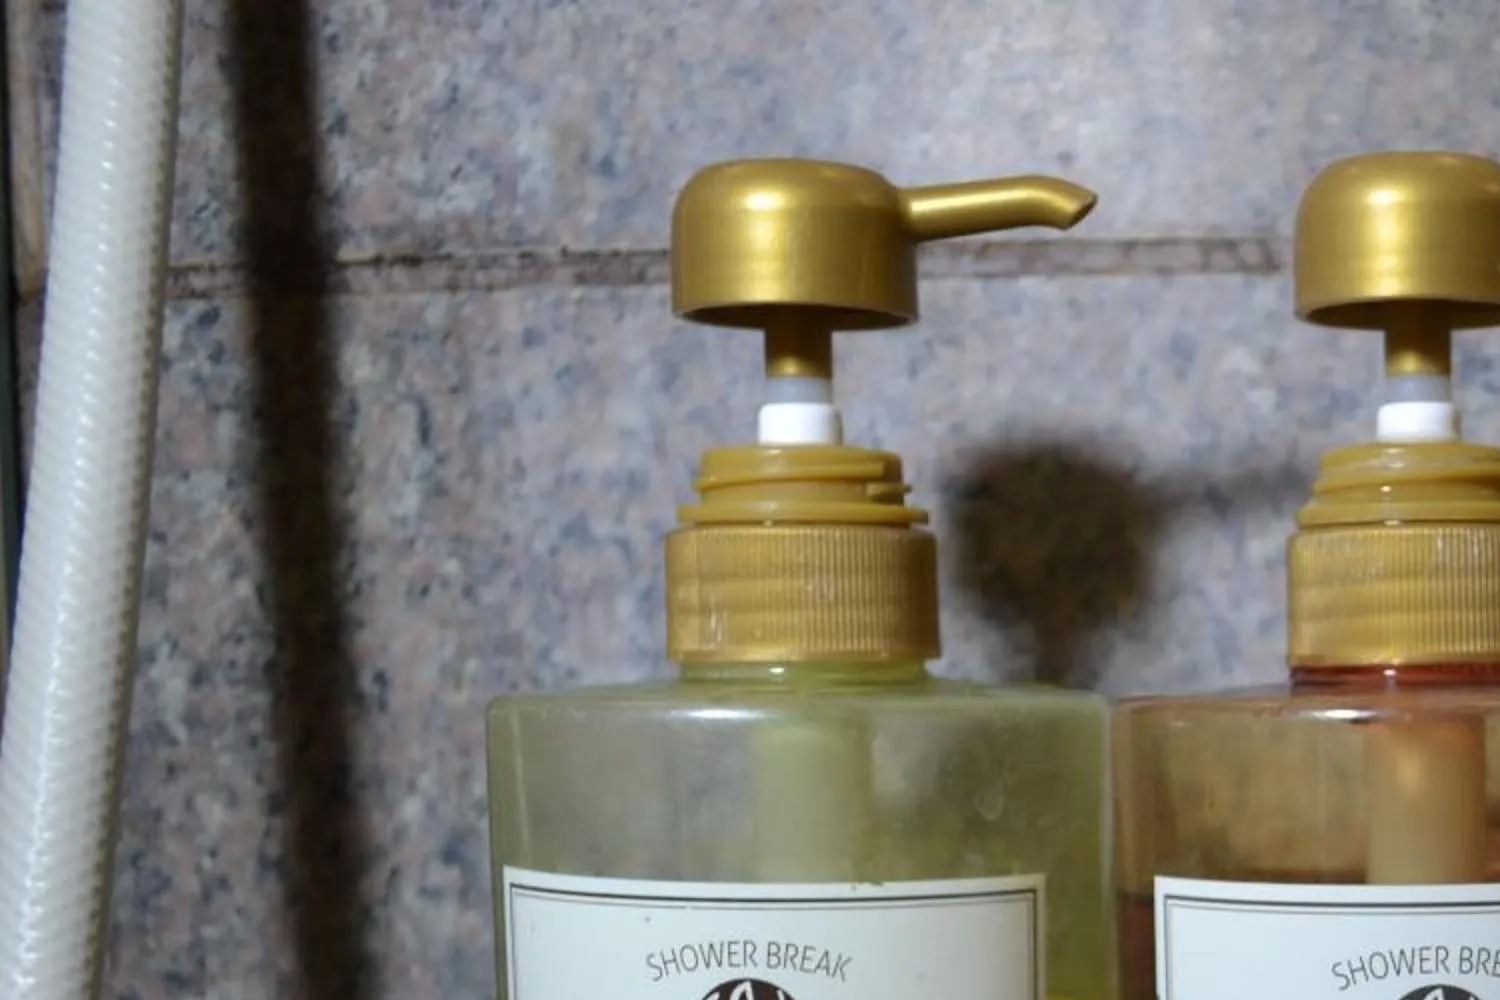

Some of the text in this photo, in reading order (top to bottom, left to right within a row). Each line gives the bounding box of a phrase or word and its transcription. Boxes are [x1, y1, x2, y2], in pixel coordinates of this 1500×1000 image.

[646, 941, 852, 982] SHOWER BREAK
[1332, 946, 1449, 991] SHOWER
